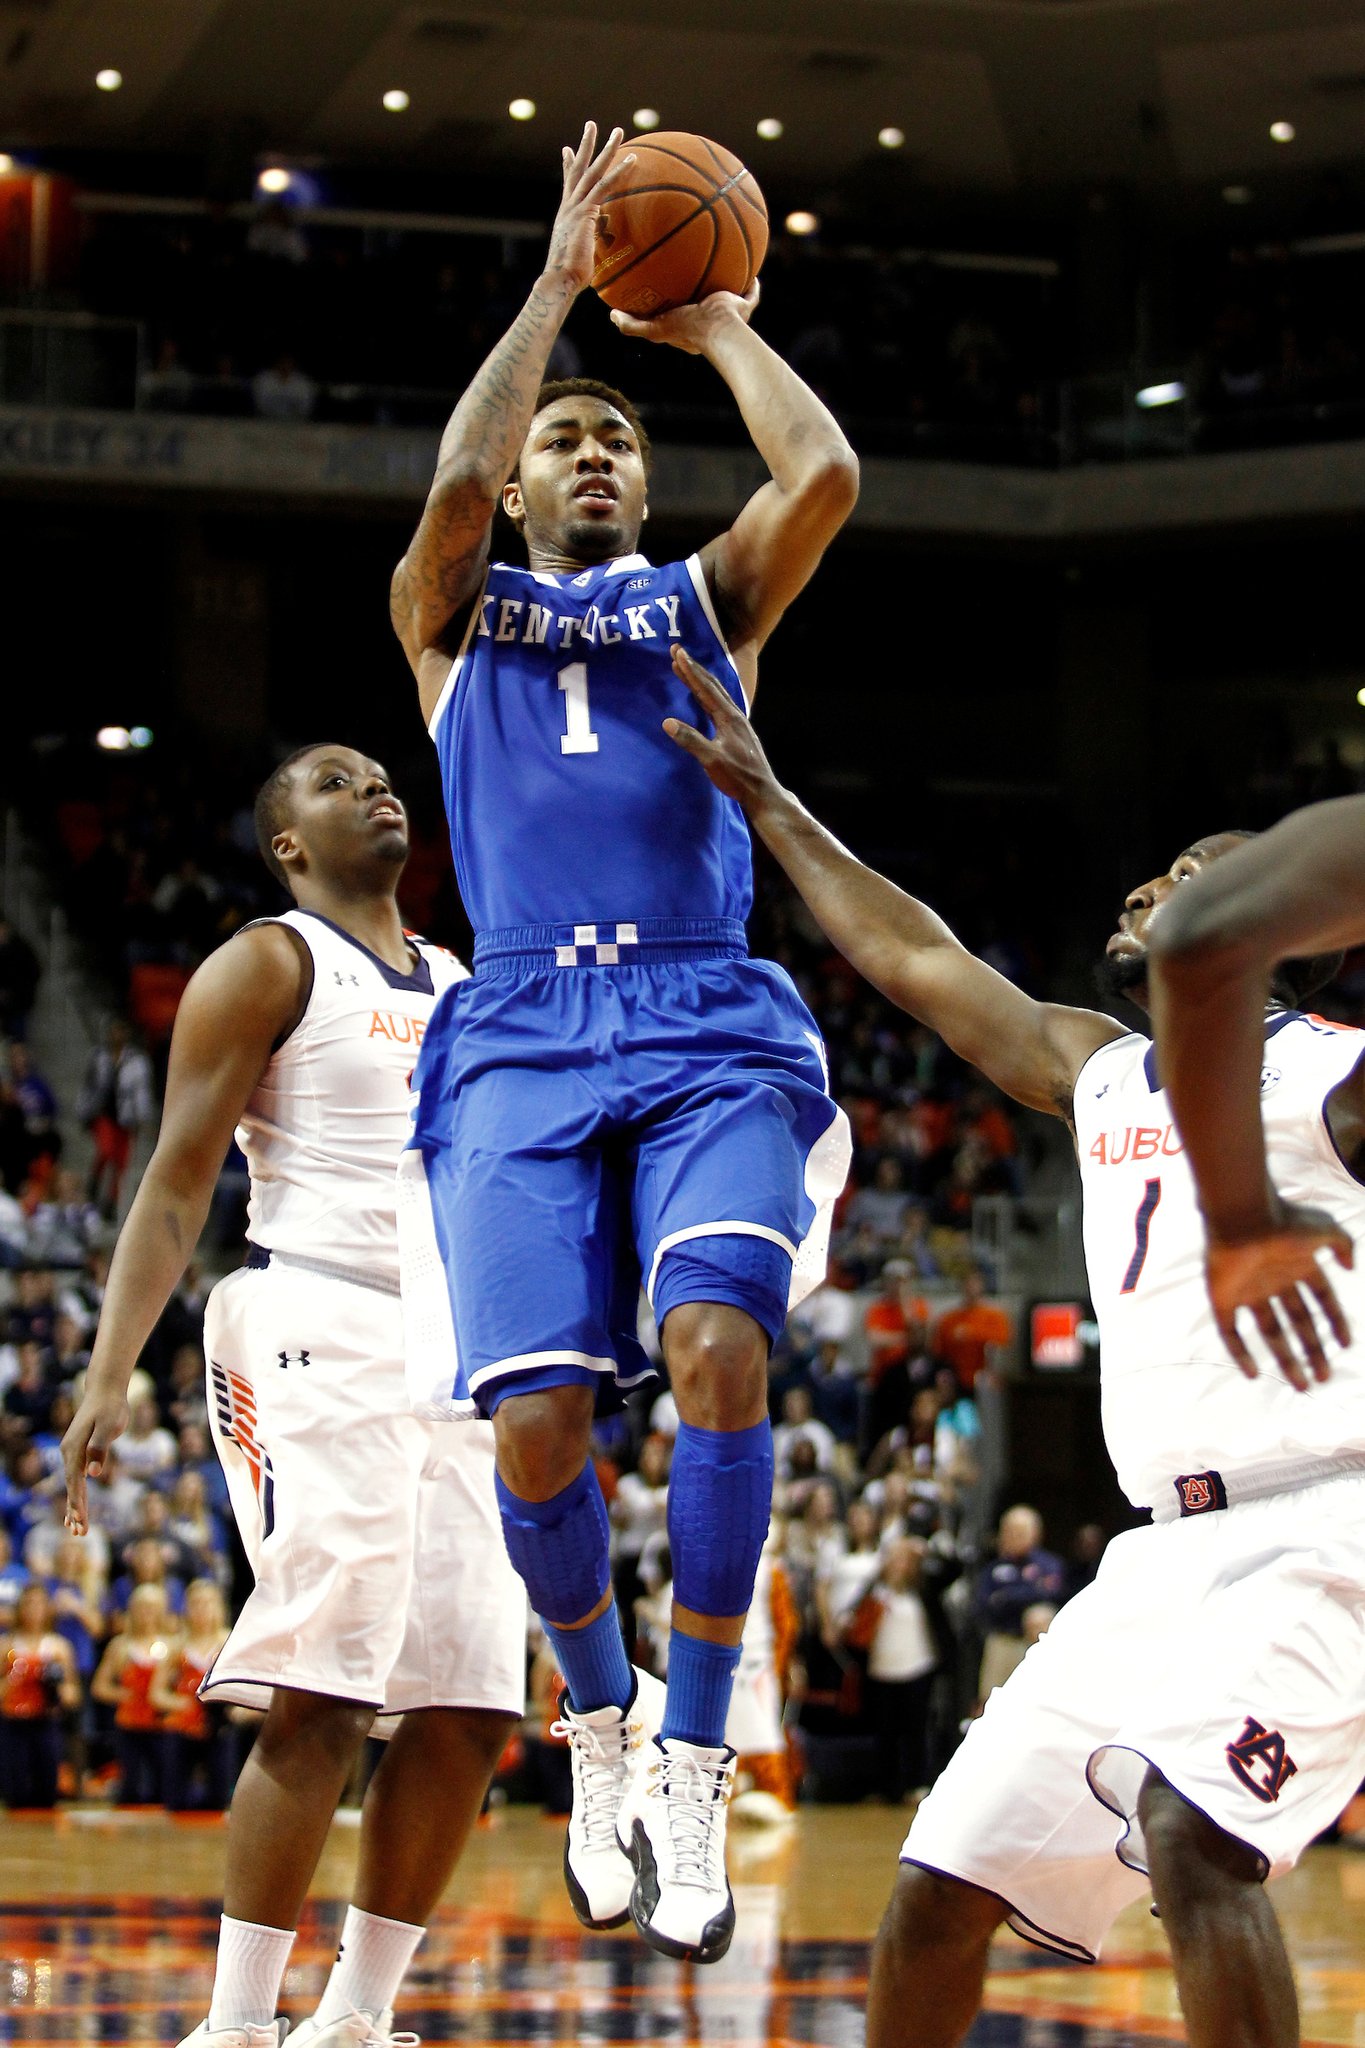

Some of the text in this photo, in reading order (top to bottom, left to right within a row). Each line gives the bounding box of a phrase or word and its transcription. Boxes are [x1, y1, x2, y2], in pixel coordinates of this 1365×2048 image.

[478, 596, 681, 648] KENTUCKY
[557, 662, 599, 754] 1
[1120, 1177, 1160, 1294] 1
